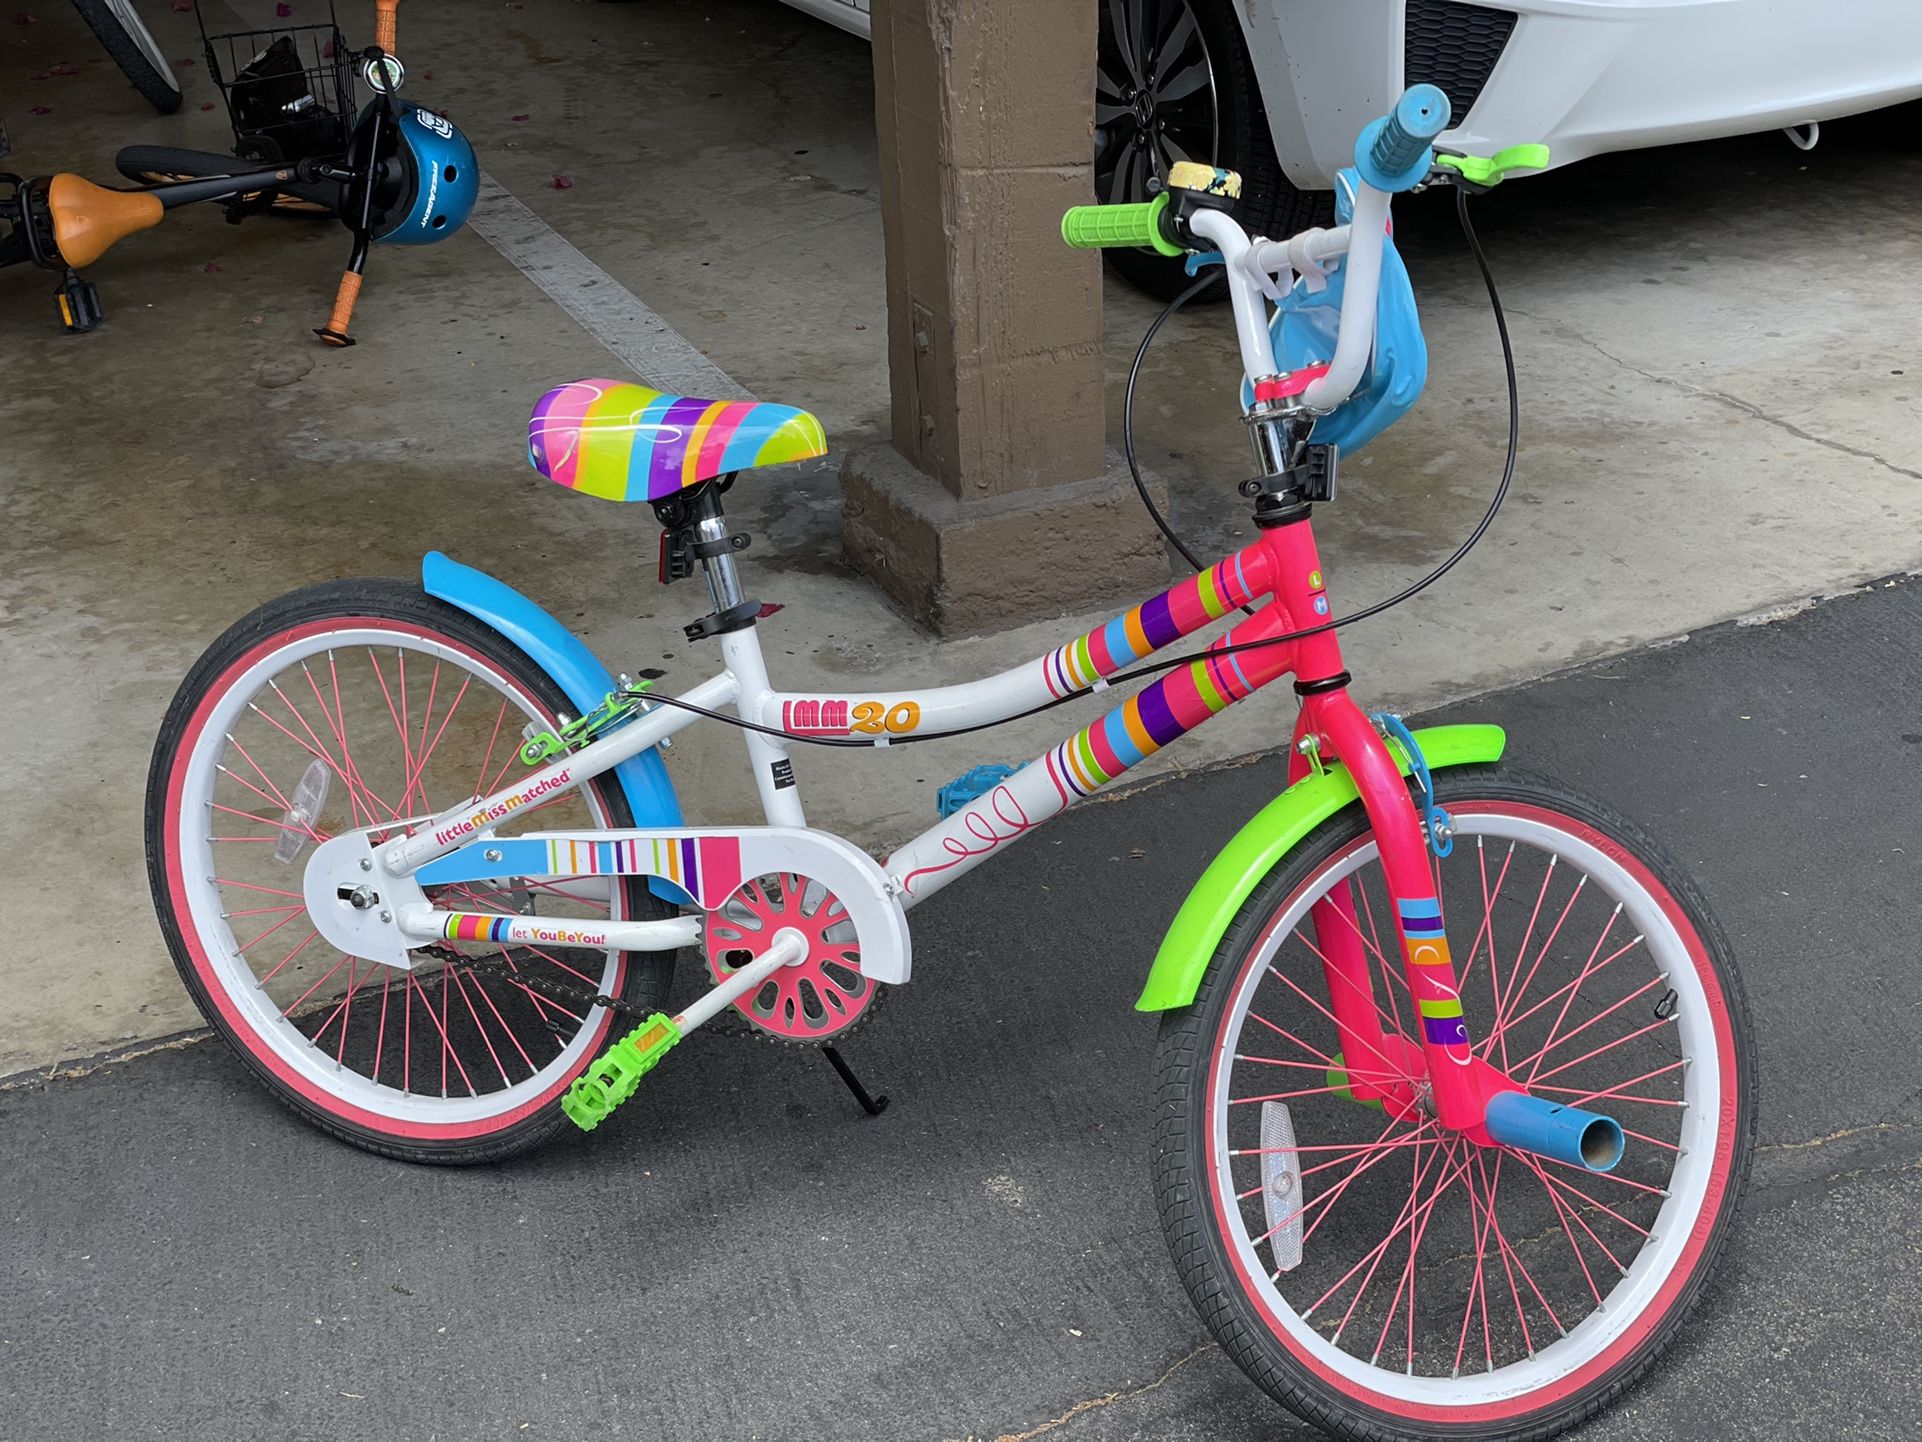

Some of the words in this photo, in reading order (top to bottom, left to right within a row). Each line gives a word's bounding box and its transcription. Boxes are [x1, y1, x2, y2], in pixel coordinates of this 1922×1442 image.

[1579, 829, 1628, 862] NYLON
[512, 926, 528, 939] let
[531, 927, 607, 945] YouBeYou!
